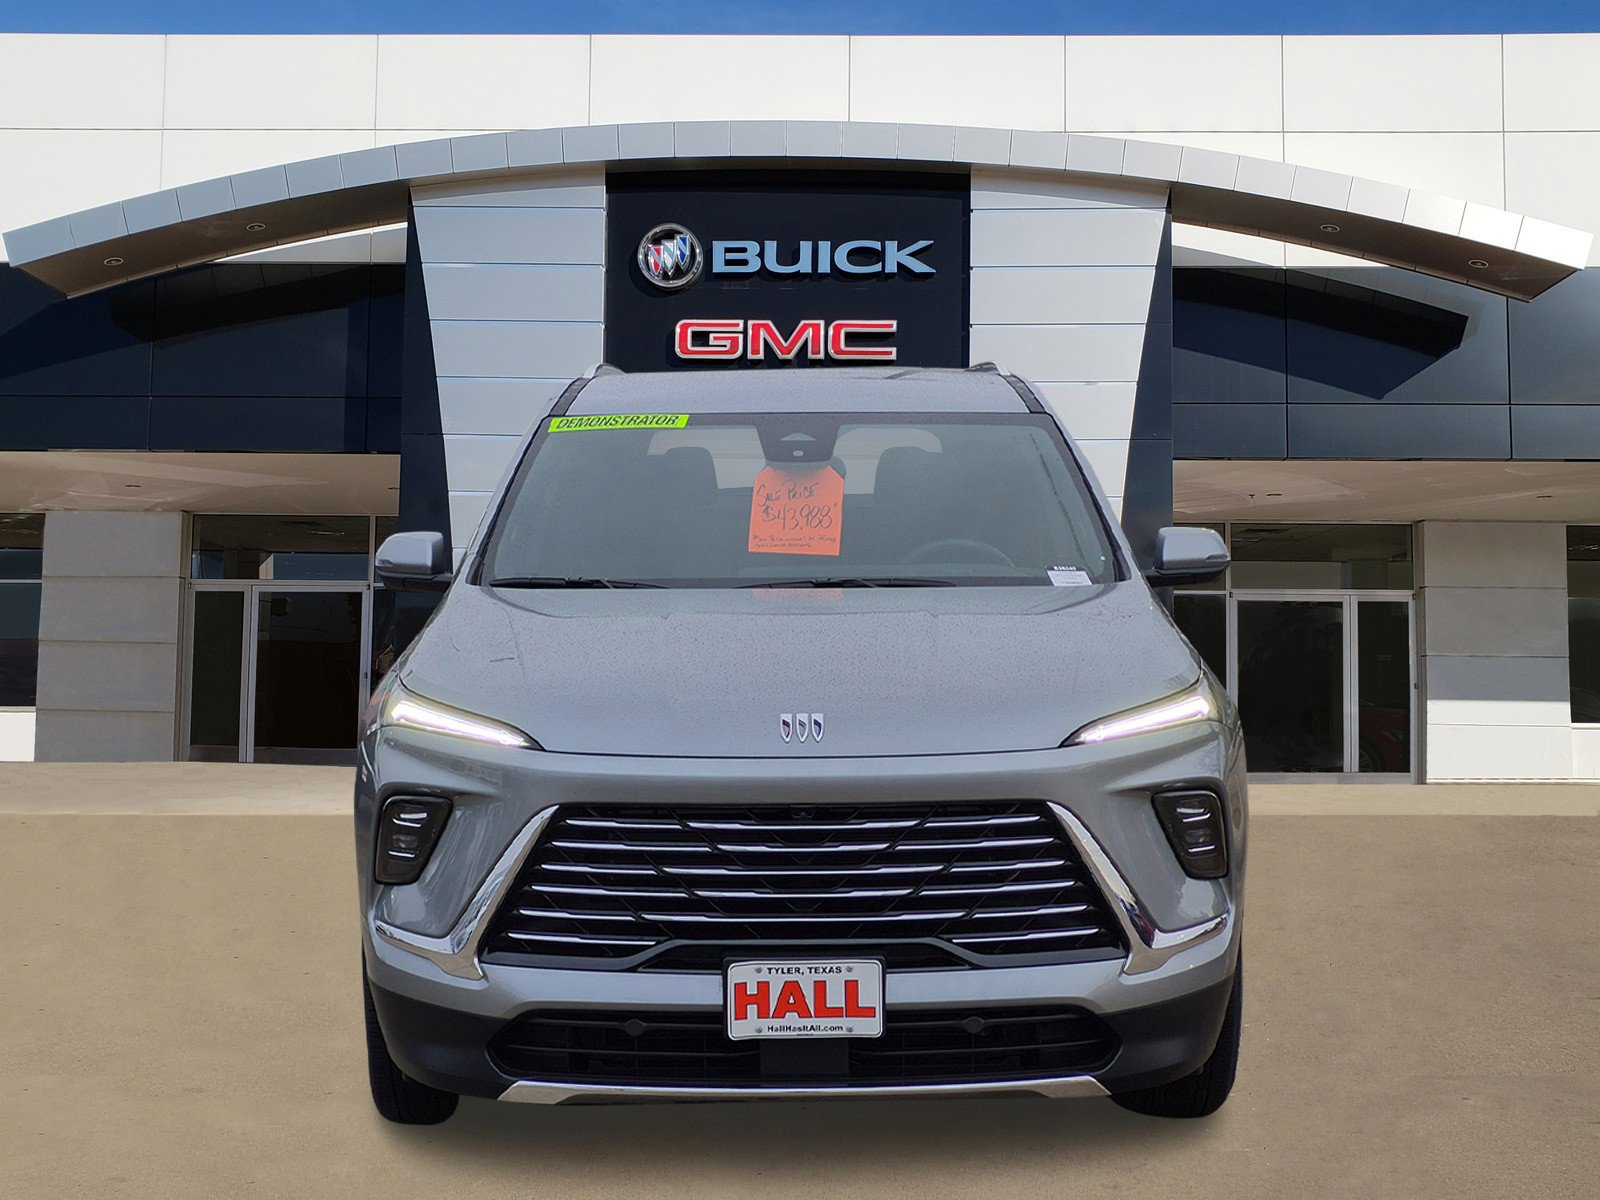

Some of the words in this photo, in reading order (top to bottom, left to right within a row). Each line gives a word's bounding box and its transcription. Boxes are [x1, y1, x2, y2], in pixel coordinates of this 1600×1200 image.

[711, 240, 937, 275] BUICK
[674, 319, 898, 361] GMC
[555, 415, 680, 430] DEMONSTRATOR
[767, 966, 805, 975] TYLER,
[808, 966, 843, 974] TEXAS
[734, 979, 876, 1021] HALL
[767, 1024, 844, 1033] HallHasItAll.com
